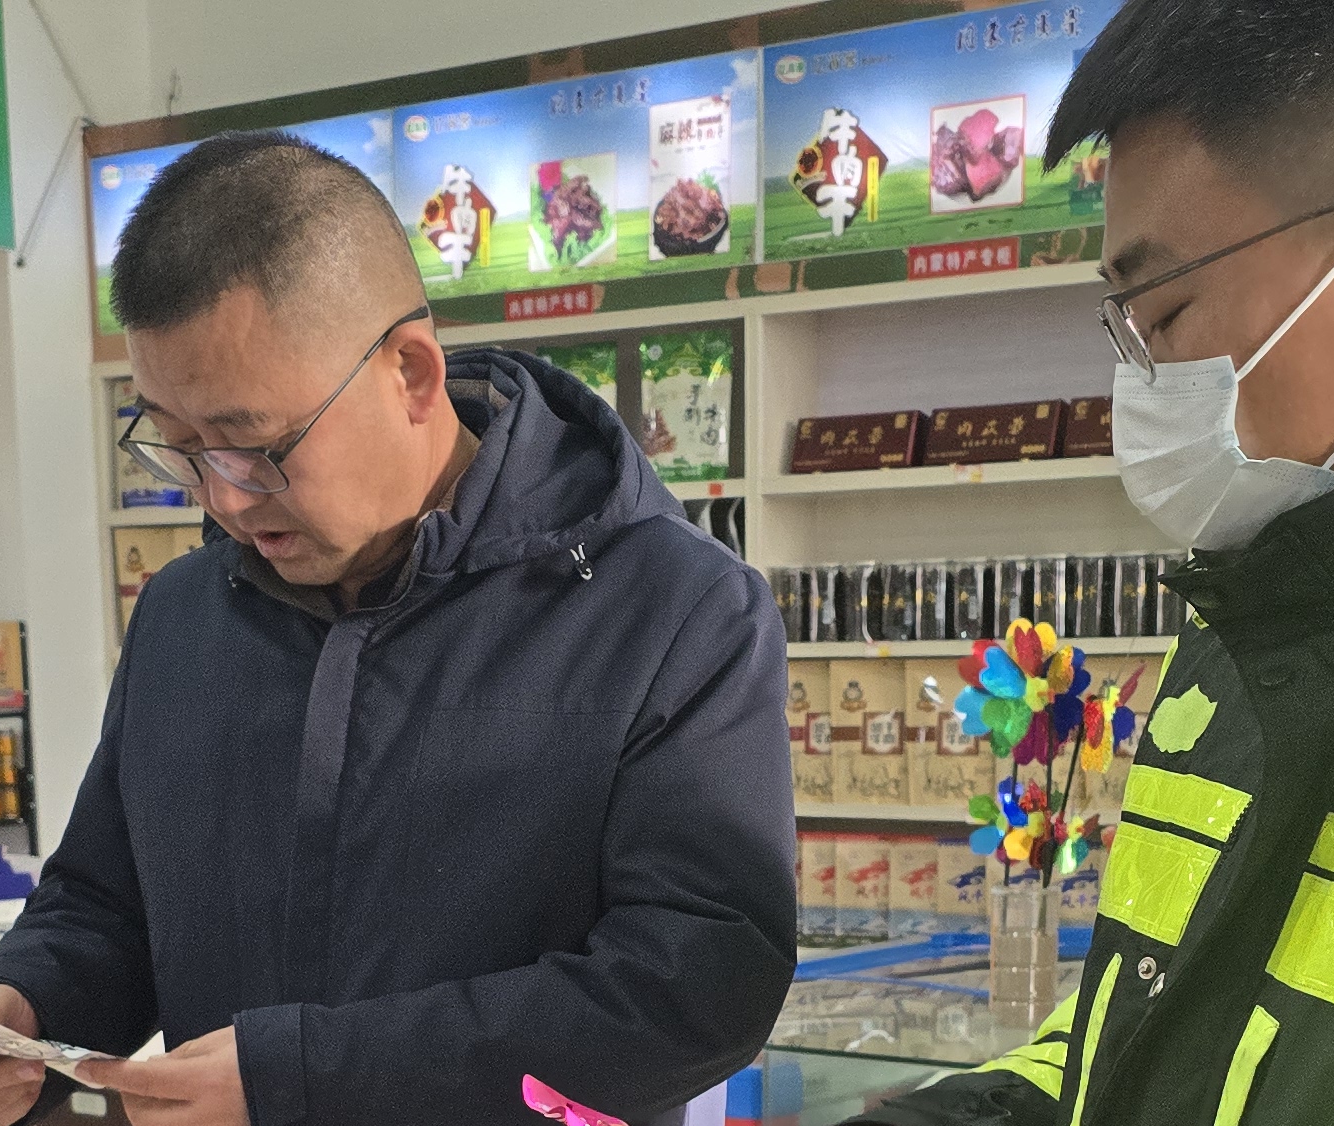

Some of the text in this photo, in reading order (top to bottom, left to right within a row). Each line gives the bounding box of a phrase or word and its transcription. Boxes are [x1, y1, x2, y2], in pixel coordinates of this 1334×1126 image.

[438, 164, 477, 279] 牛肉干
[816, 108, 863, 237] 牛肉干
